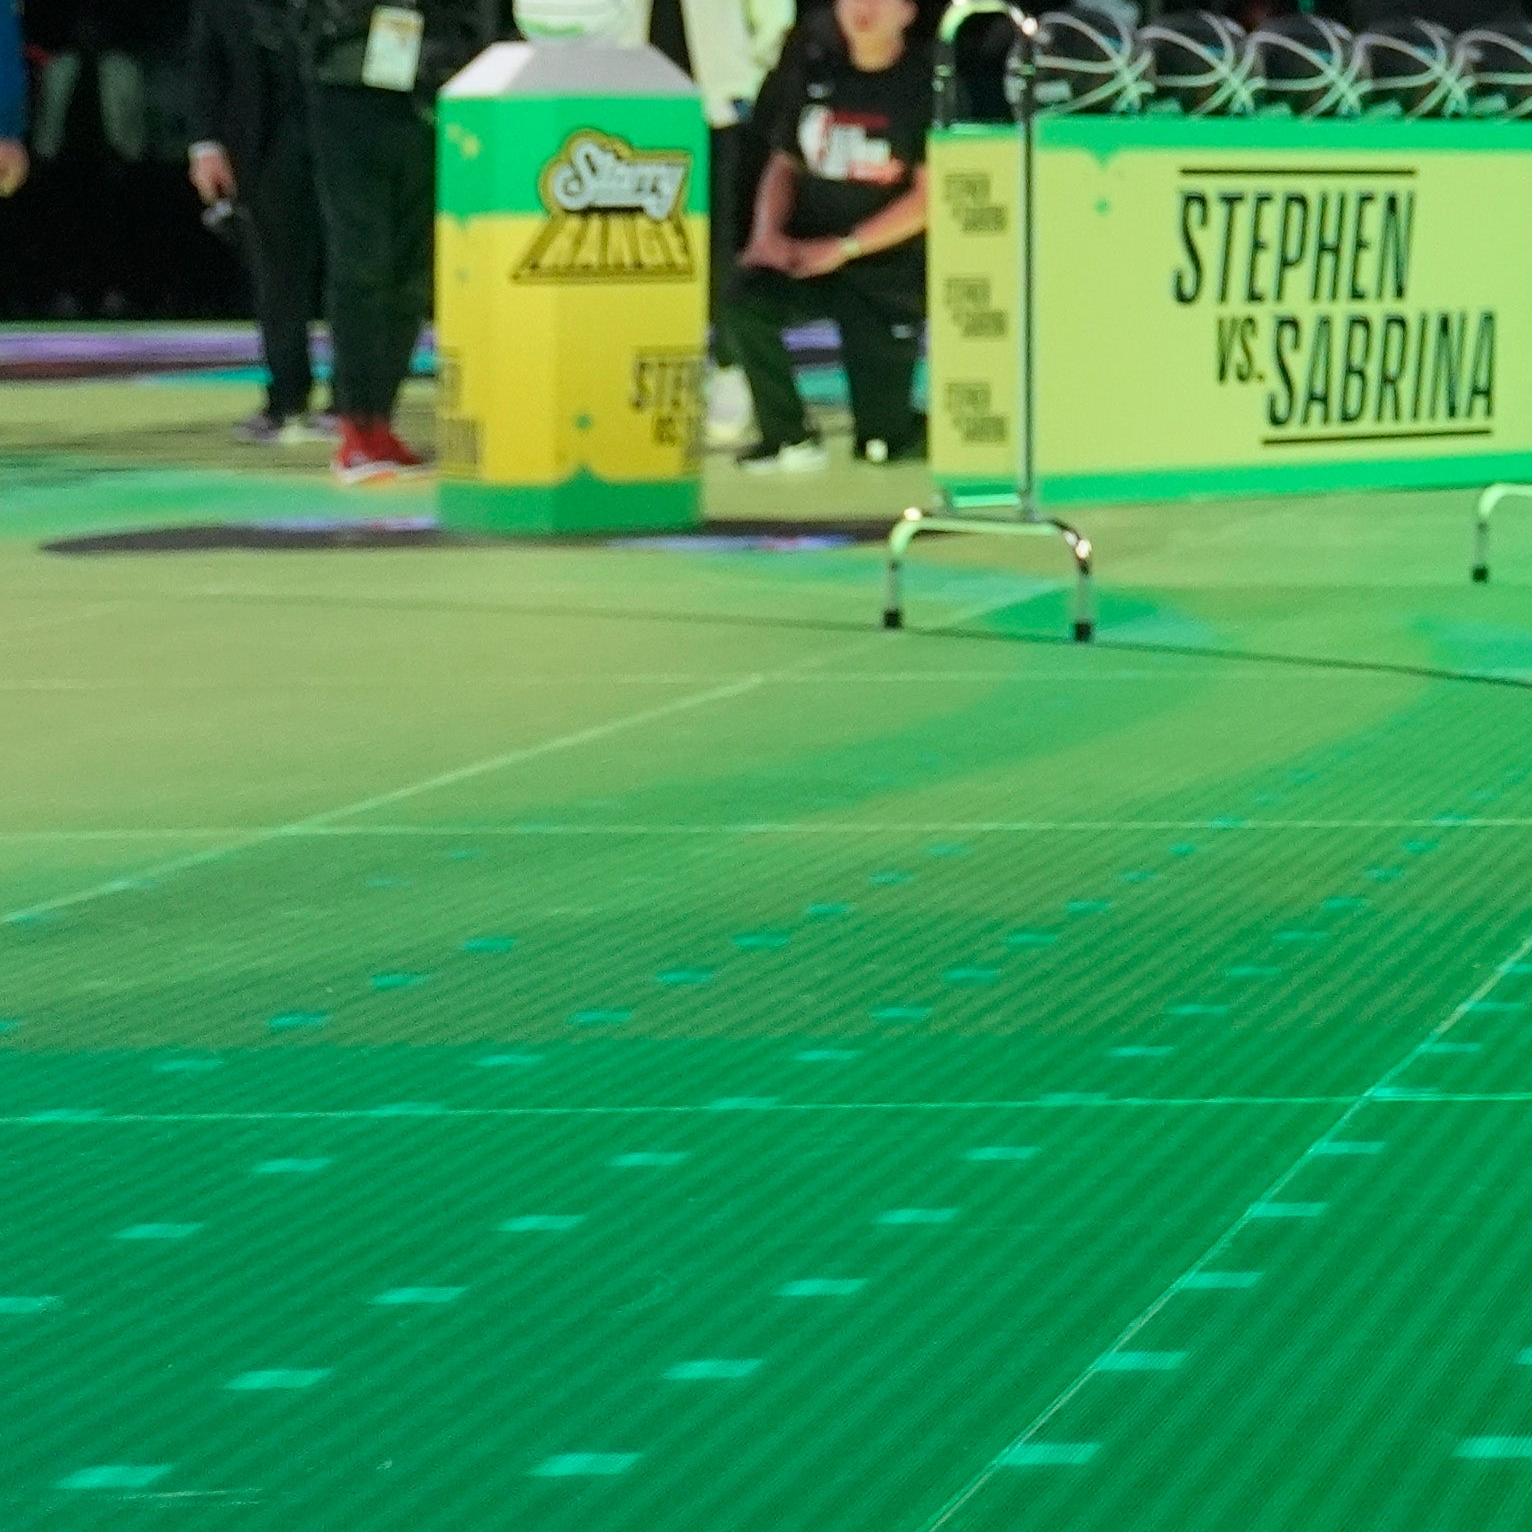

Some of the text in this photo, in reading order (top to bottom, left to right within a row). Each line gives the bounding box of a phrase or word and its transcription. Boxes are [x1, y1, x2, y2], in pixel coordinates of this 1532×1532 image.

[540, 215, 690, 270] RANGE
[1173, 186, 1417, 307] STEPHEN
[1215, 310, 1498, 428] VS. SABRINA
